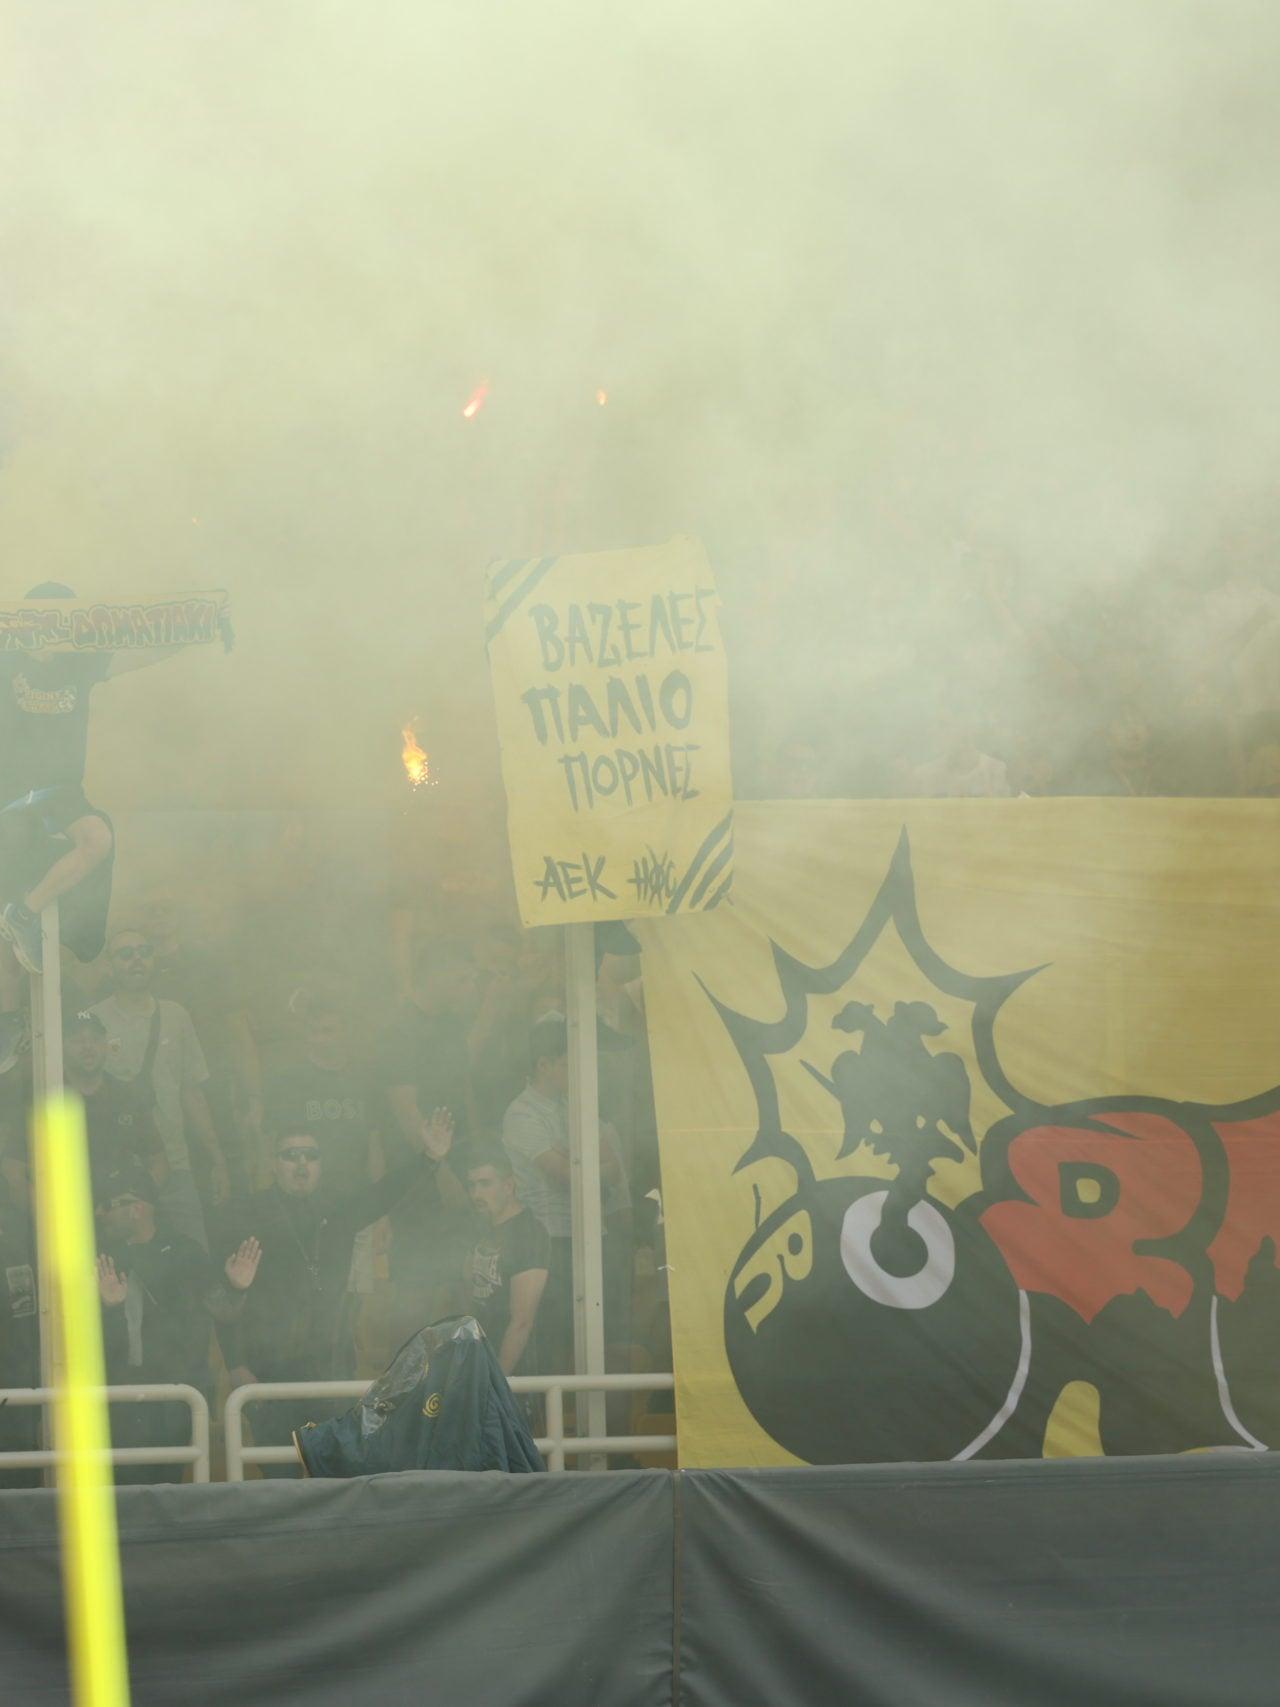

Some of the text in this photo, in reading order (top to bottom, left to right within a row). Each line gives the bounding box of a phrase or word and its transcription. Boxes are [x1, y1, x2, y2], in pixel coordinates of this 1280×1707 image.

[528, 584, 716, 672] ΒΑΖΕΛΕΣ
[520, 669, 694, 746] ΠΑΛΙΟ
[557, 743, 702, 813] ΠΟΡΝΕΣ
